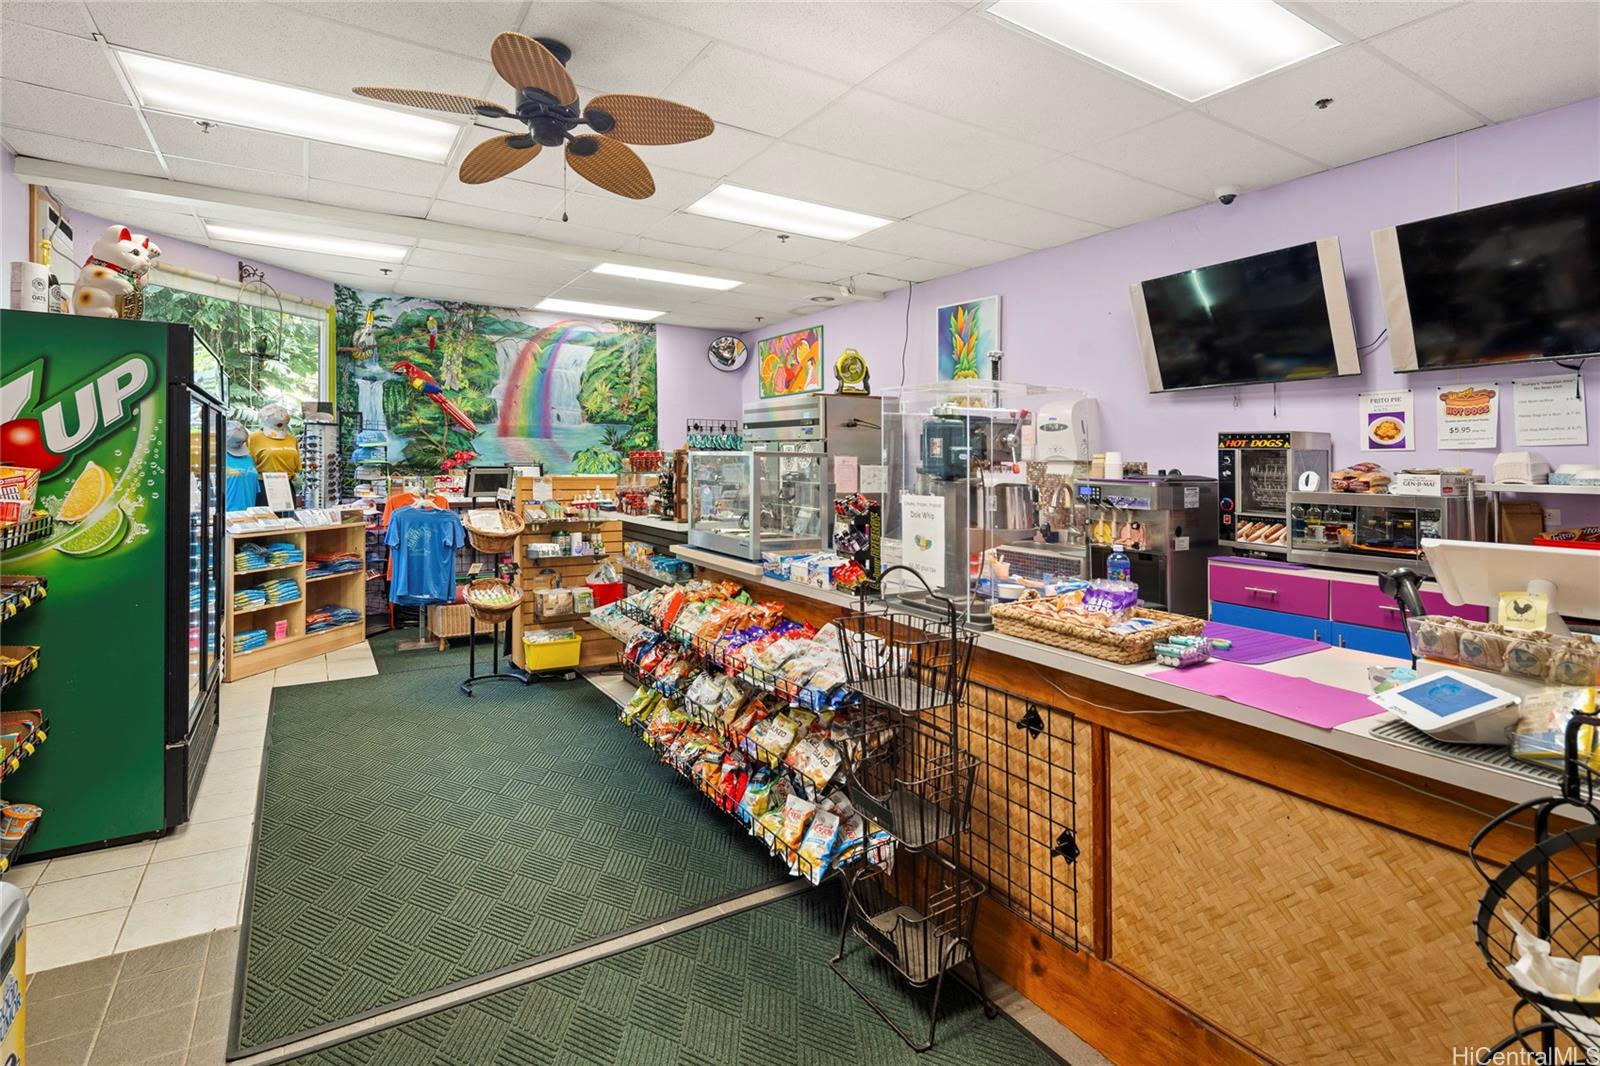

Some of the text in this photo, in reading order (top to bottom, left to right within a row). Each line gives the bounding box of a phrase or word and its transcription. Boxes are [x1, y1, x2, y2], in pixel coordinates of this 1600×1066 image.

[1445, 405, 1490, 416] HOT DOGS
[1449, 426, 1471, 434] $5.95
[1225, 439, 1284, 448] HOT DOGS
